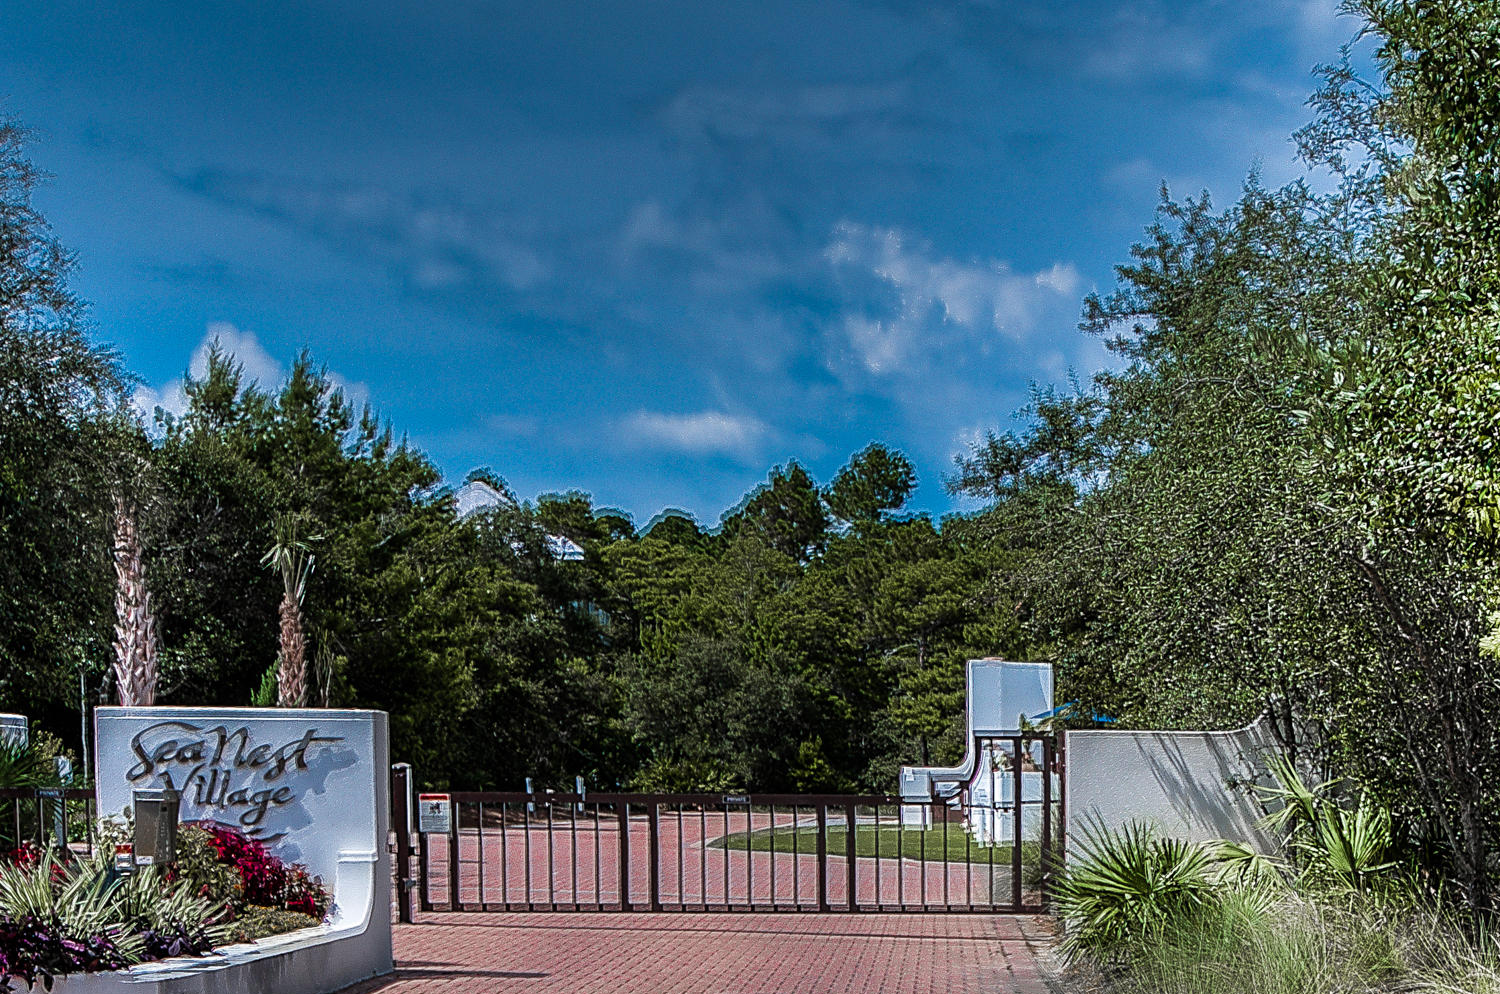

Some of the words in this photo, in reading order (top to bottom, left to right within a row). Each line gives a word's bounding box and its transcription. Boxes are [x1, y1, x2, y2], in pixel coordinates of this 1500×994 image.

[125, 721, 205, 781] Sea
[204, 725, 345, 781] Nest
[157, 763, 296, 826] Village
